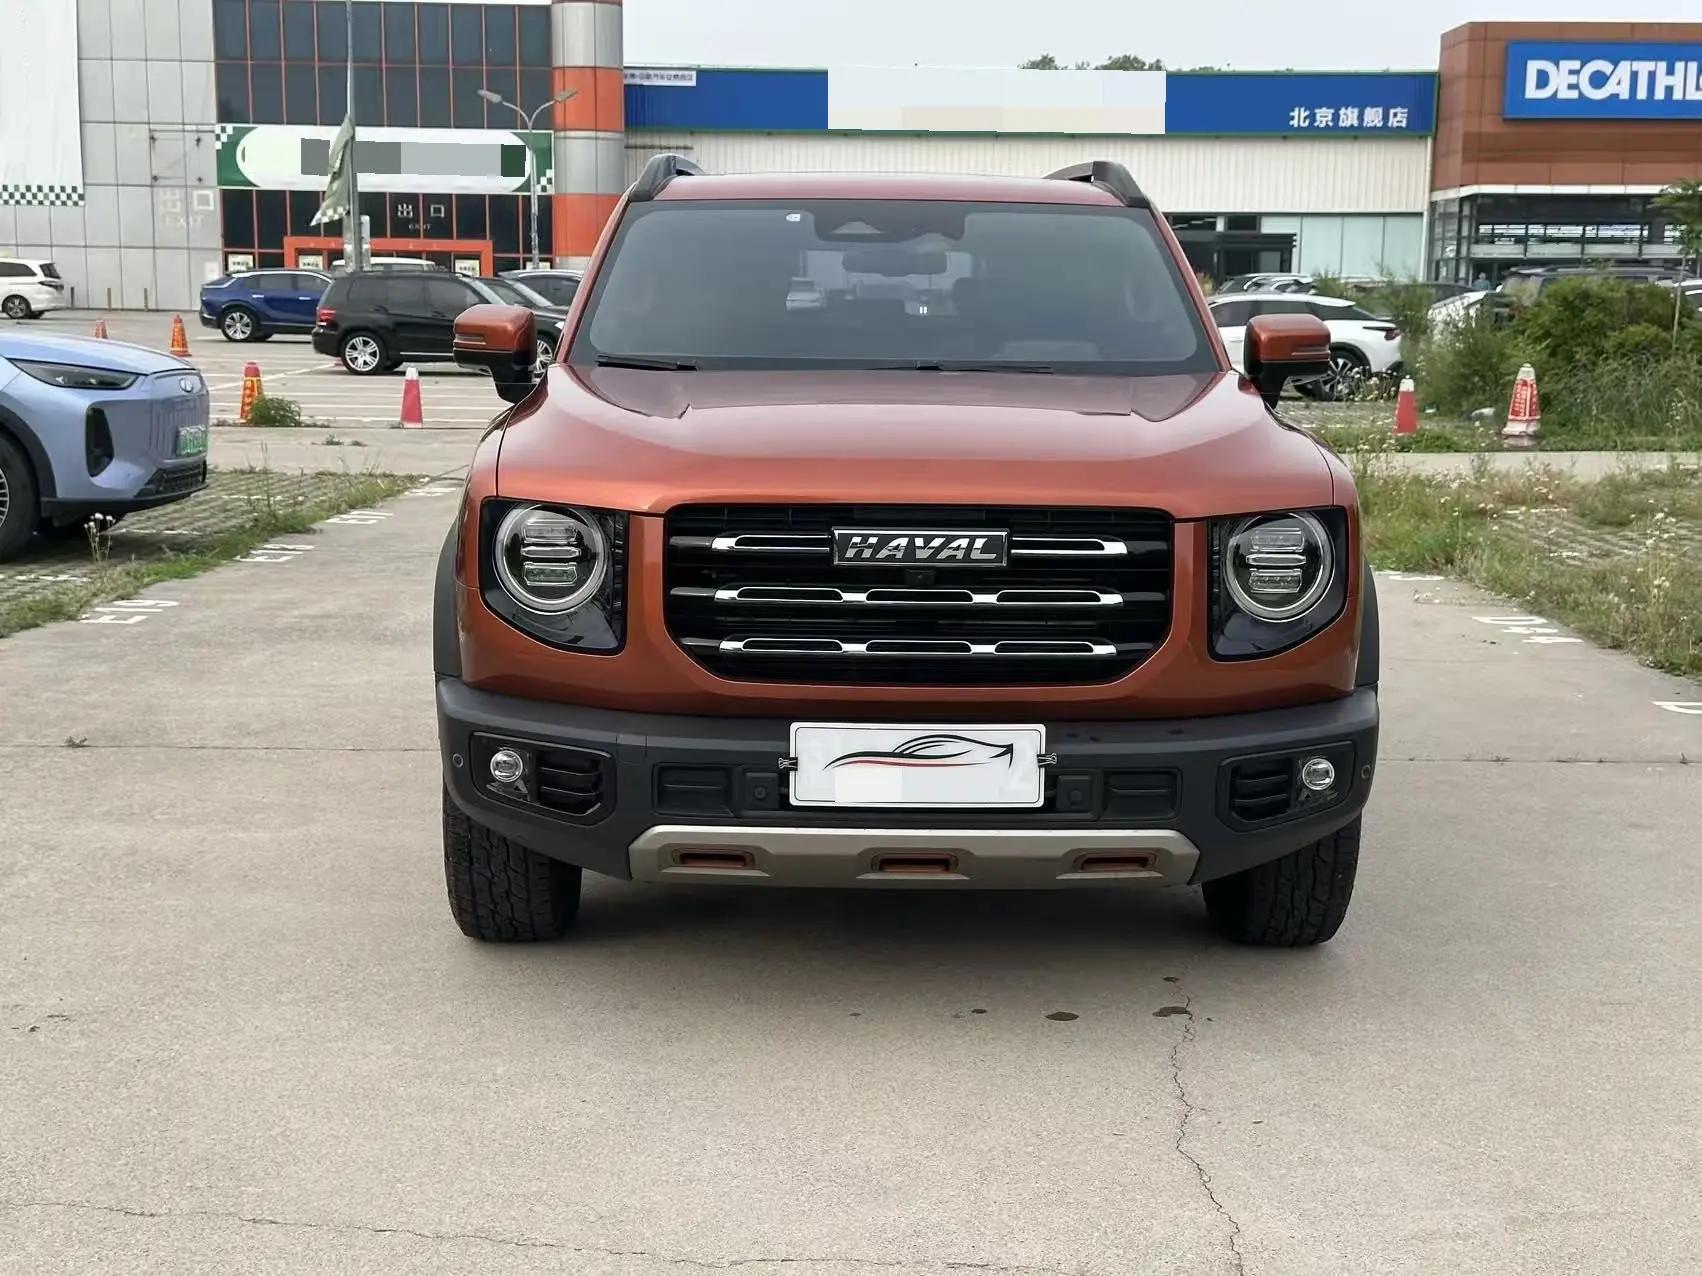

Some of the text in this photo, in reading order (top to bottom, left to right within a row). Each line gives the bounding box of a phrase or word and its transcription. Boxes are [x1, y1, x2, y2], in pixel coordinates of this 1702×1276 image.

[1524, 58, 1702, 101] DECATHL
[1288, 106, 1409, 128] 北京旗舰店
[397, 202, 445, 219] 出口
[844, 536, 998, 560] HAVAL
